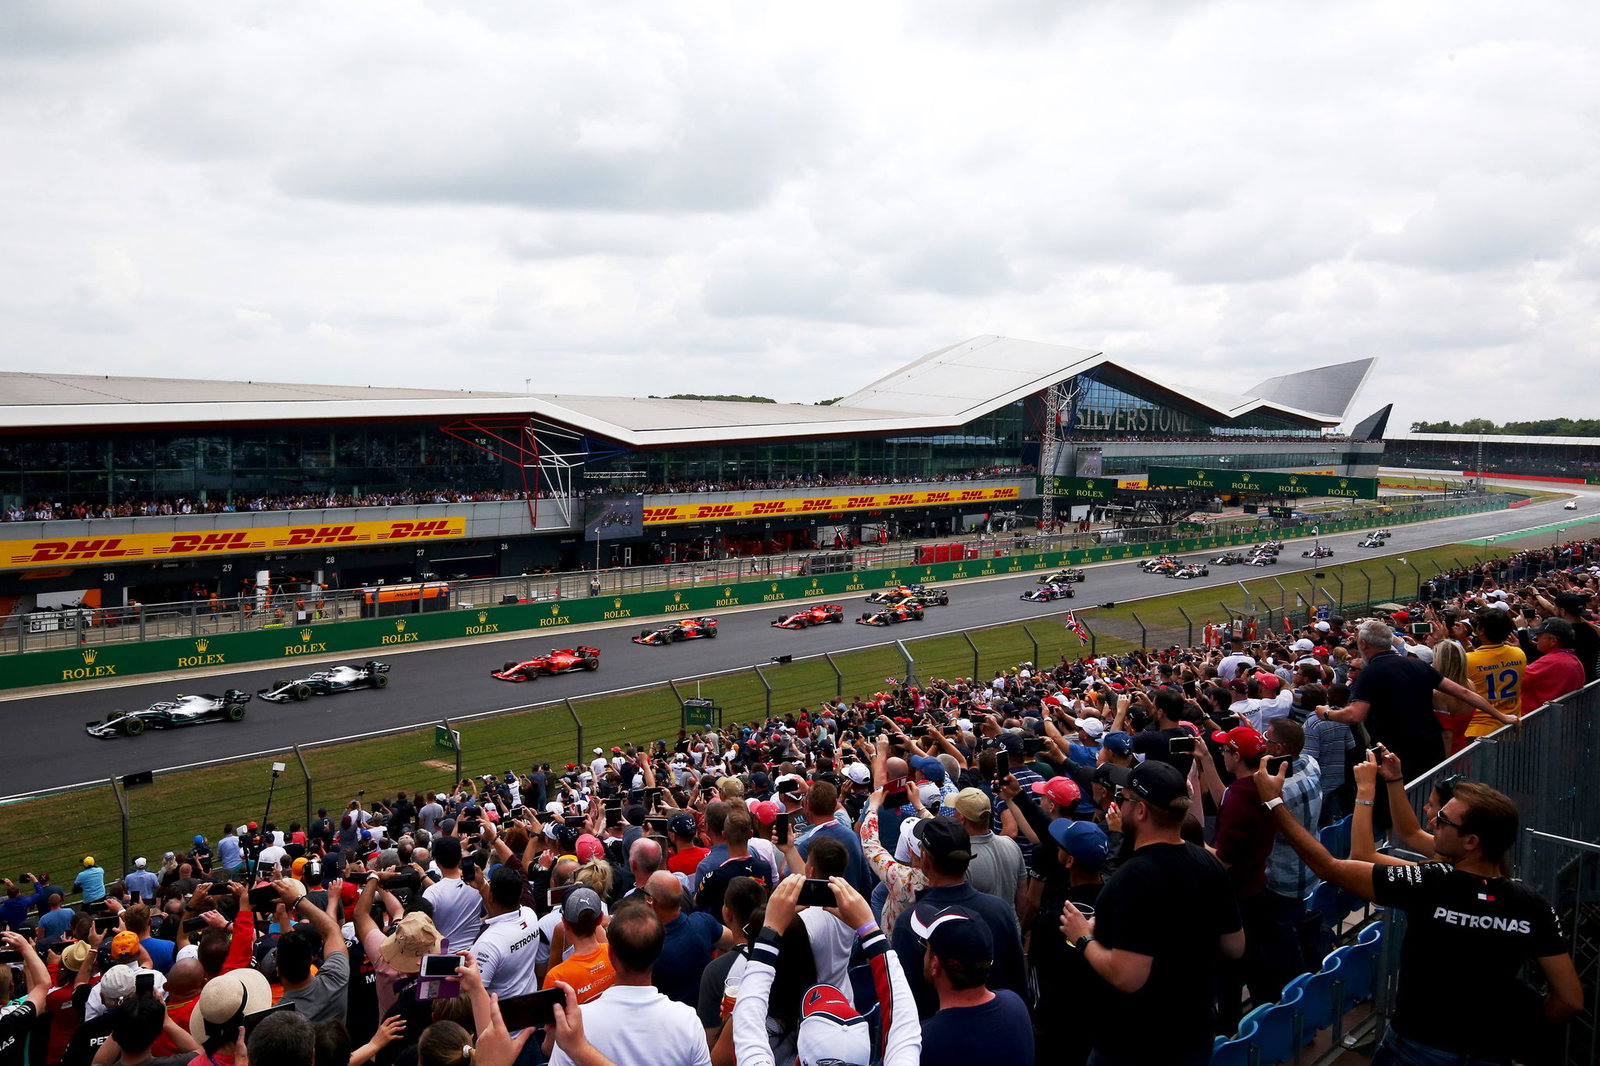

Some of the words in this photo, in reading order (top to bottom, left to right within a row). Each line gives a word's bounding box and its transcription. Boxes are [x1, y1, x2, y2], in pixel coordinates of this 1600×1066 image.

[1232, 482, 1260, 491] ROLEX
[1278, 485, 1308, 493] ROLEX
[926, 492, 950, 503] DHL
[961, 490, 983, 500] DHL
[993, 488, 1014, 498] DHL
[1076, 489, 1104, 498] ROLEX
[1328, 488, 1359, 497] ROLEX
[802, 499, 834, 511] DHL
[847, 496, 876, 508] DHL
[889, 494, 914, 505] DHL
[697, 505, 735, 518] DHL
[752, 501, 787, 514] DHL
[643, 508, 679, 521] DHL
[389, 520, 451, 539] DHL
[287, 526, 358, 545] DHL
[169, 532, 251, 553] DHL
[31, 539, 126, 562] DHL
[326, 556, 335, 564] 28
[222, 564, 233, 572] 29
[981, 568, 995, 576] ROLEX
[103, 572, 115, 582] 30
[920, 575, 936, 583] ROLEX
[846, 583, 865, 591] ROLEX
[884, 579, 901, 587] ROLEX
[763, 592, 785, 601] ROLEX
[804, 588, 824, 597] ROLEX
[665, 603, 690, 612] ROLEX
[716, 597, 738, 607] ROLEX
[604, 609, 631, 619] ROLEX
[540, 616, 570, 627] ROLEX
[466, 623, 499, 635] ROLEX
[382, 632, 419, 644] ROLEX
[284, 642, 327, 656] ROLEX
[177, 653, 225, 667] ROLEX
[62, 664, 117, 680] ROLEX
[1476, 663, 1500, 672] Team
[1485, 668, 1519, 700] 12
[1433, 906, 1532, 935] PETRONAS
[509, 929, 541, 954] PETRONA
